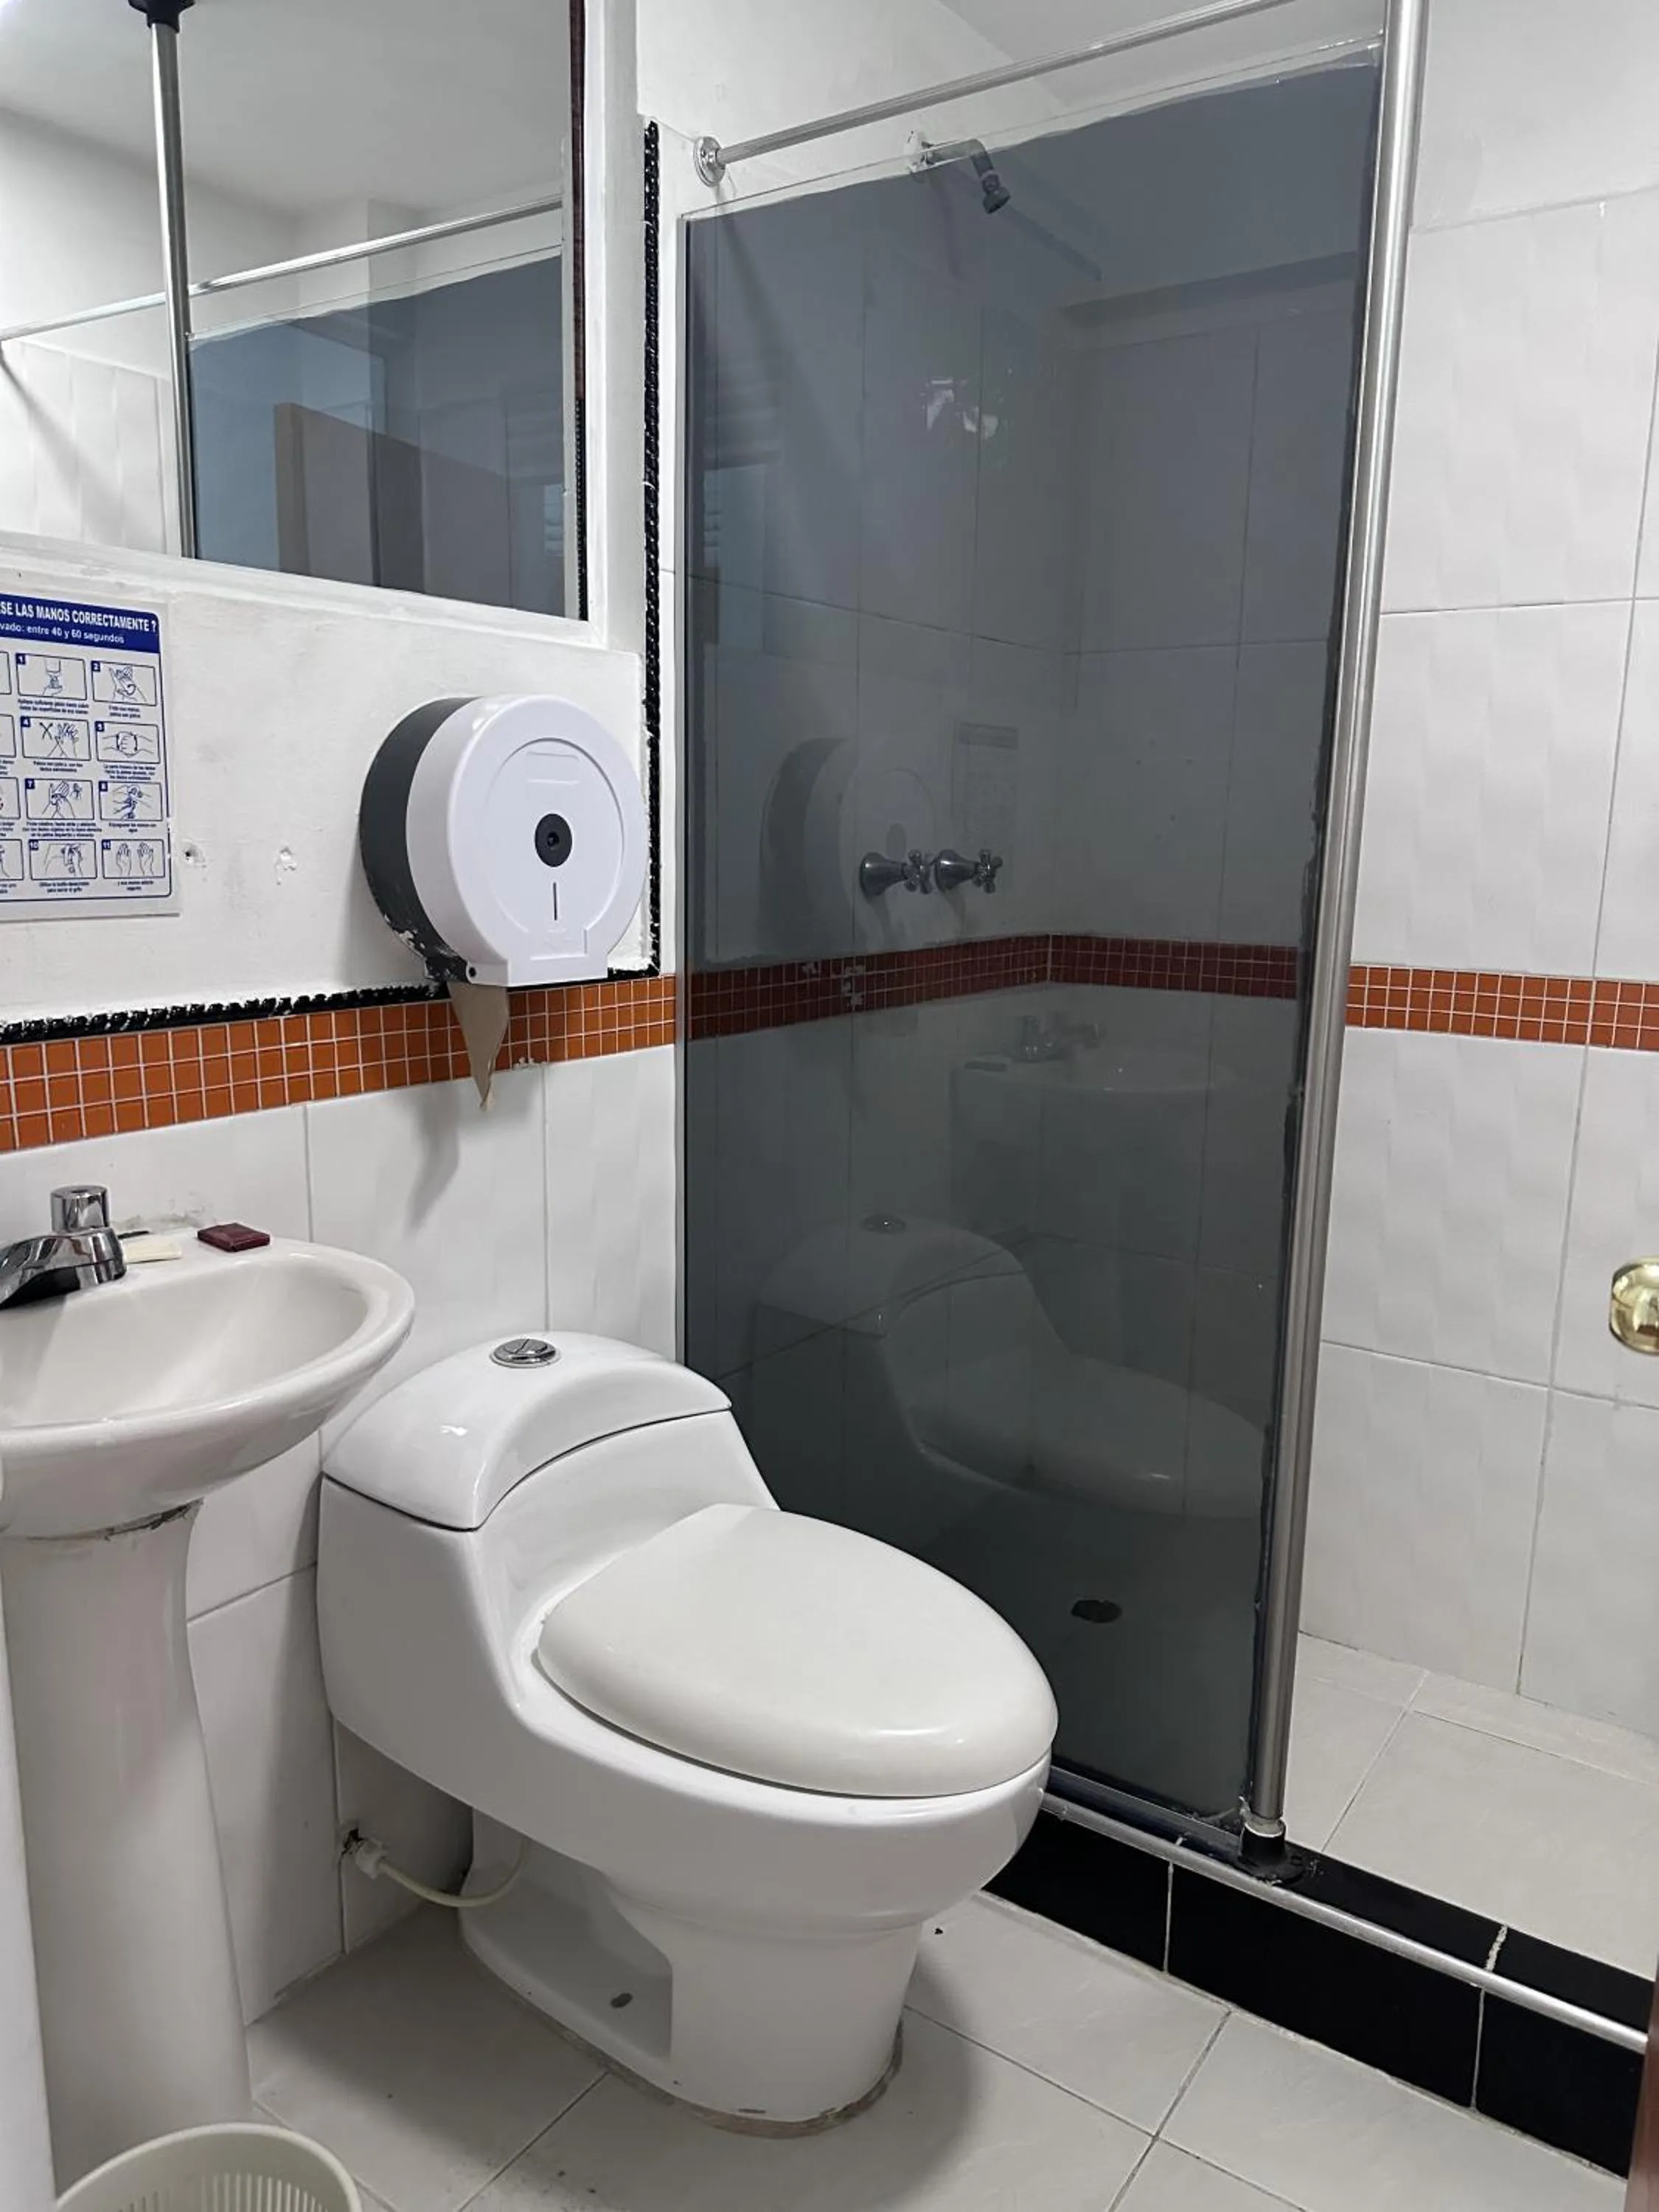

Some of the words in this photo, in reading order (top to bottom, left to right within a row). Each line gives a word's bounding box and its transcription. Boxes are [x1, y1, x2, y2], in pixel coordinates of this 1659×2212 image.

[15, 602, 34, 618] LAS
[36, 605, 70, 622] MANOS
[72, 609, 150, 632] CORRECTAMENTE
[27, 625, 49, 635] entre
[52, 626, 62, 636] 40
[63, 630, 69, 639] y
[72, 629, 81, 639] 60
[83, 632, 125, 644] segundos
